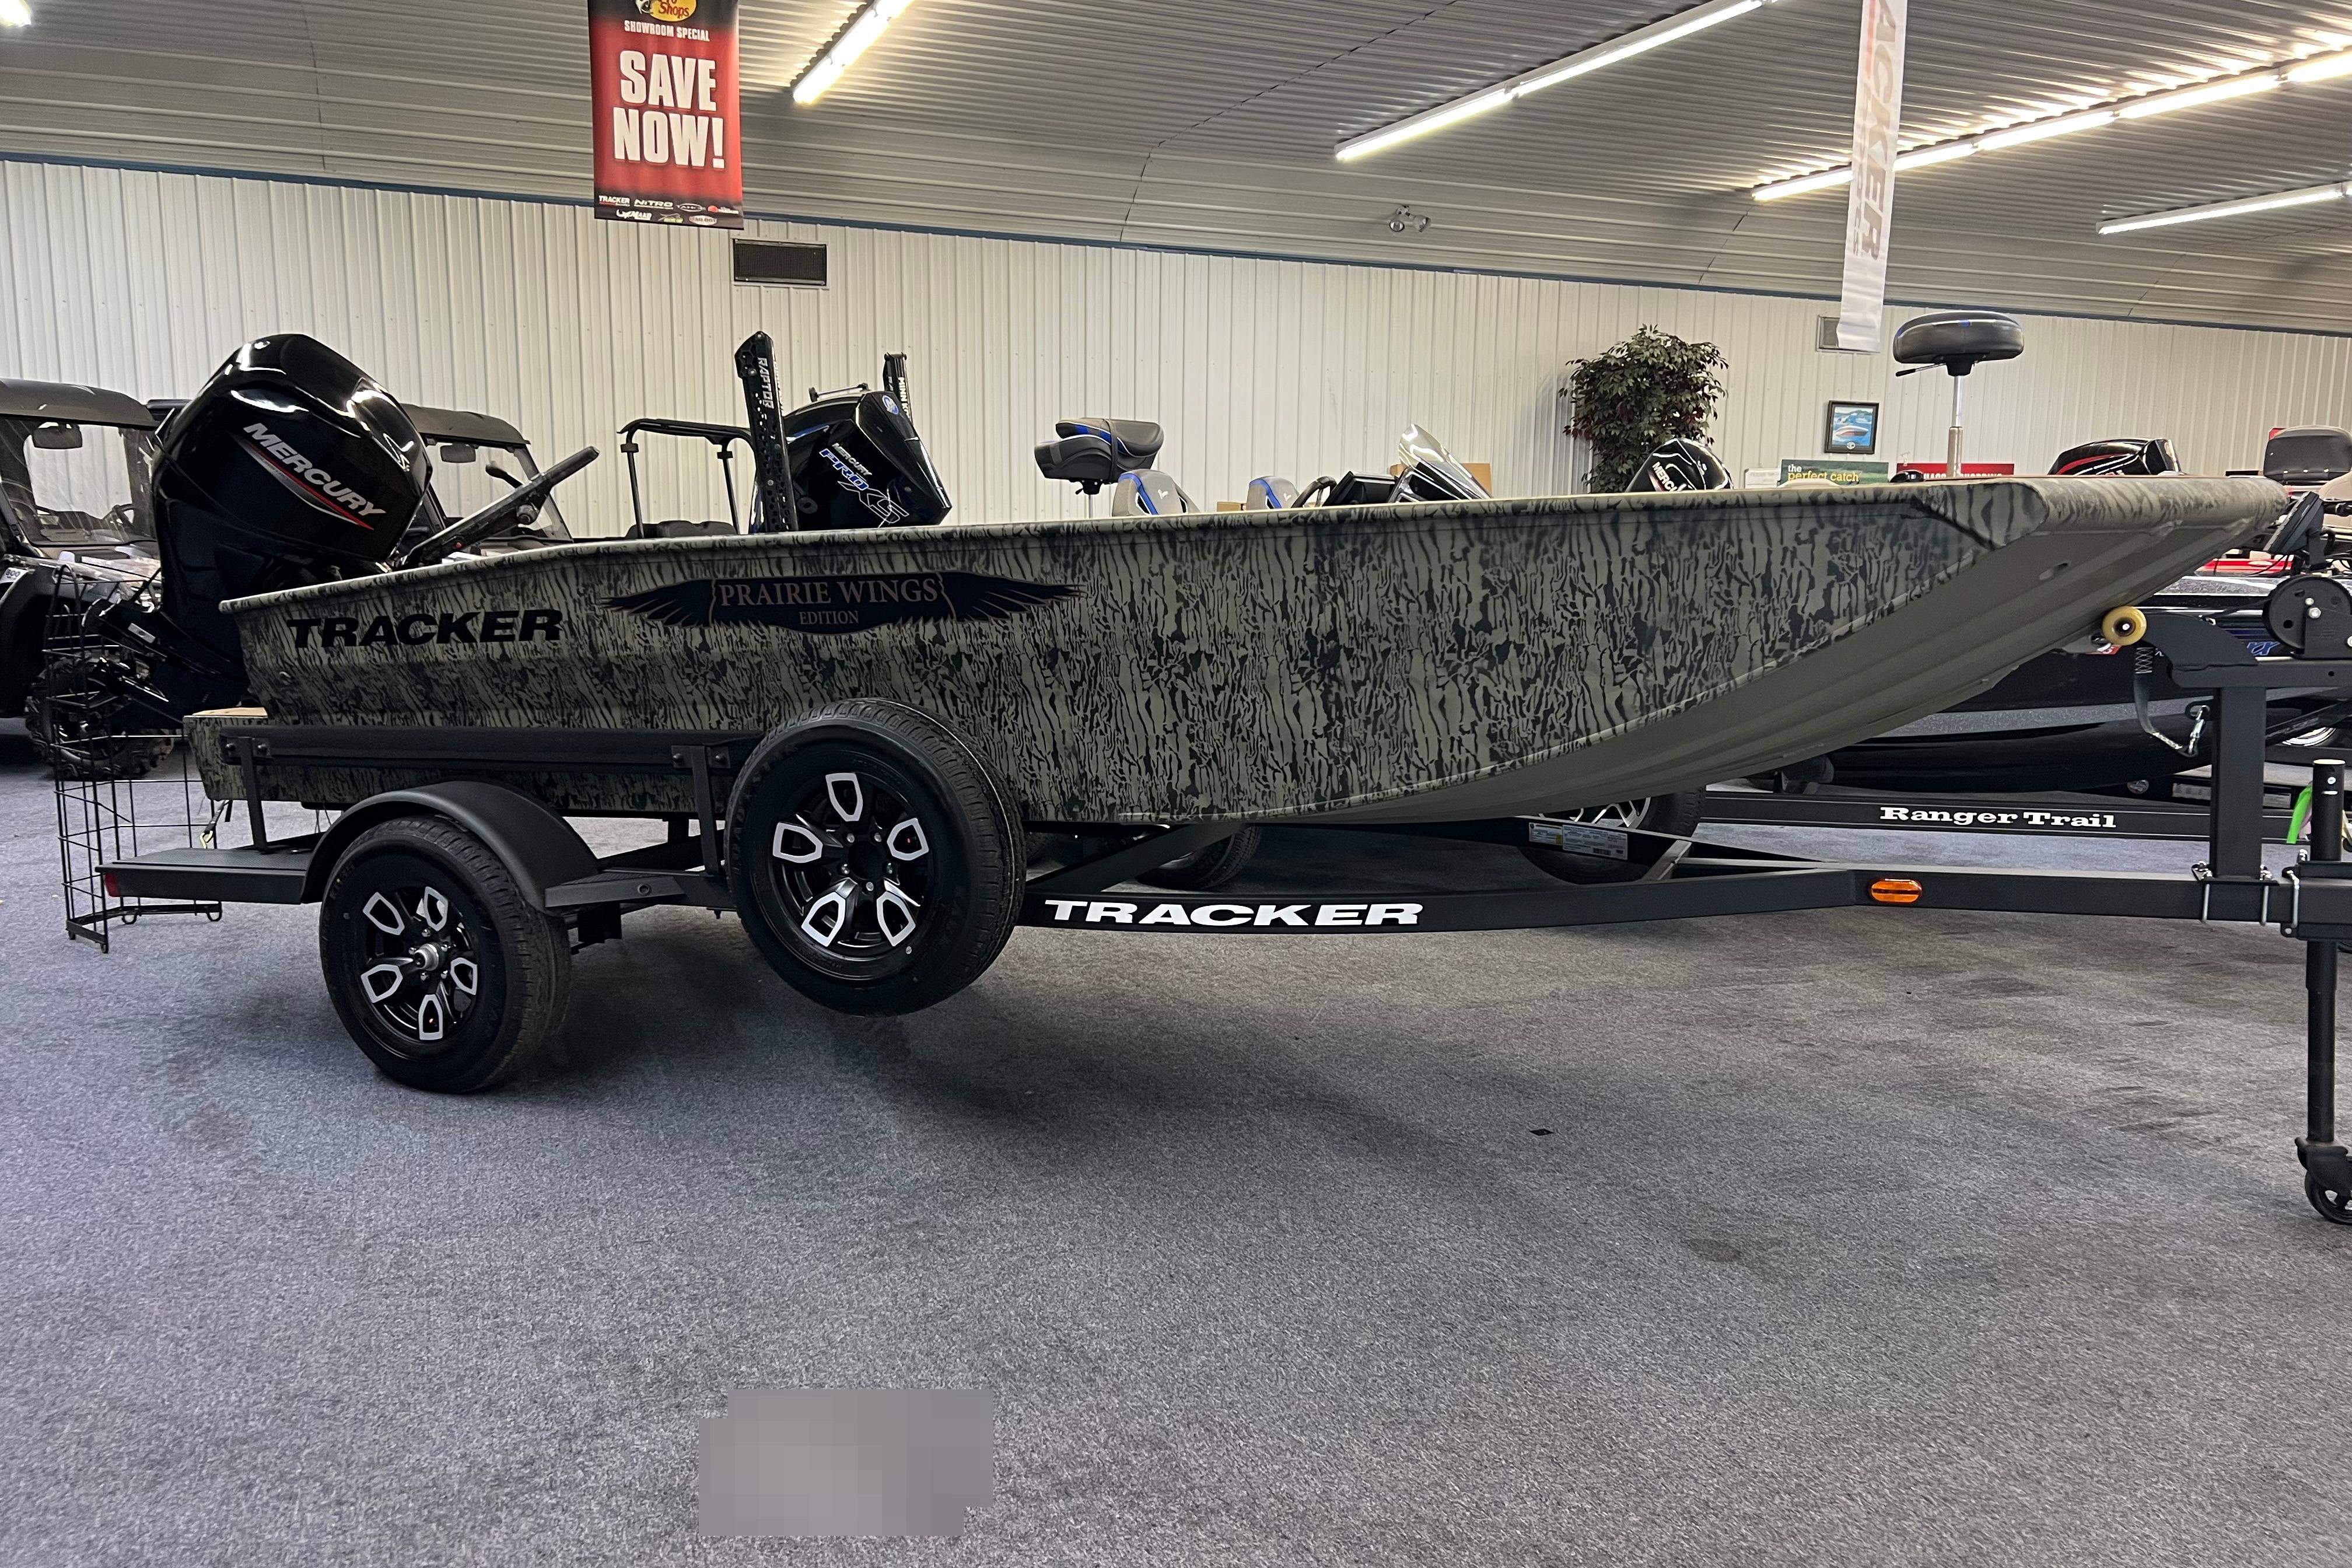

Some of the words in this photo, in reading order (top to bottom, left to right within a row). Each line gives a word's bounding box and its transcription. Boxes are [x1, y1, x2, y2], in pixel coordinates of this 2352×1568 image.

[658, 2, 690, 19] Shops
[624, 20, 674, 37] SHOWROOM
[676, 27, 710, 42] SPECIAL
[620, 50, 717, 111] SAVE
[613, 107, 725, 169] NOW!
[598, 195, 630, 204] TRACKER
[758, 357, 774, 409] RAPTOR
[898, 377, 908, 402] MINN
[243, 422, 387, 516] MERCURY
[819, 448, 869, 491] PRO
[832, 443, 873, 475] MERCURY
[1788, 464, 1803, 473] the
[1788, 470, 1828, 481] perfect
[1830, 471, 1860, 482] catch
[718, 582, 831, 606] PRAIRIE
[836, 579, 939, 604] WINGS
[286, 609, 563, 648] TRACKER
[799, 610, 859, 625] EDITION
[1880, 807, 2018, 825] Ranger
[2022, 812, 2117, 828] Trail
[1045, 900, 1423, 926] TRACKER
